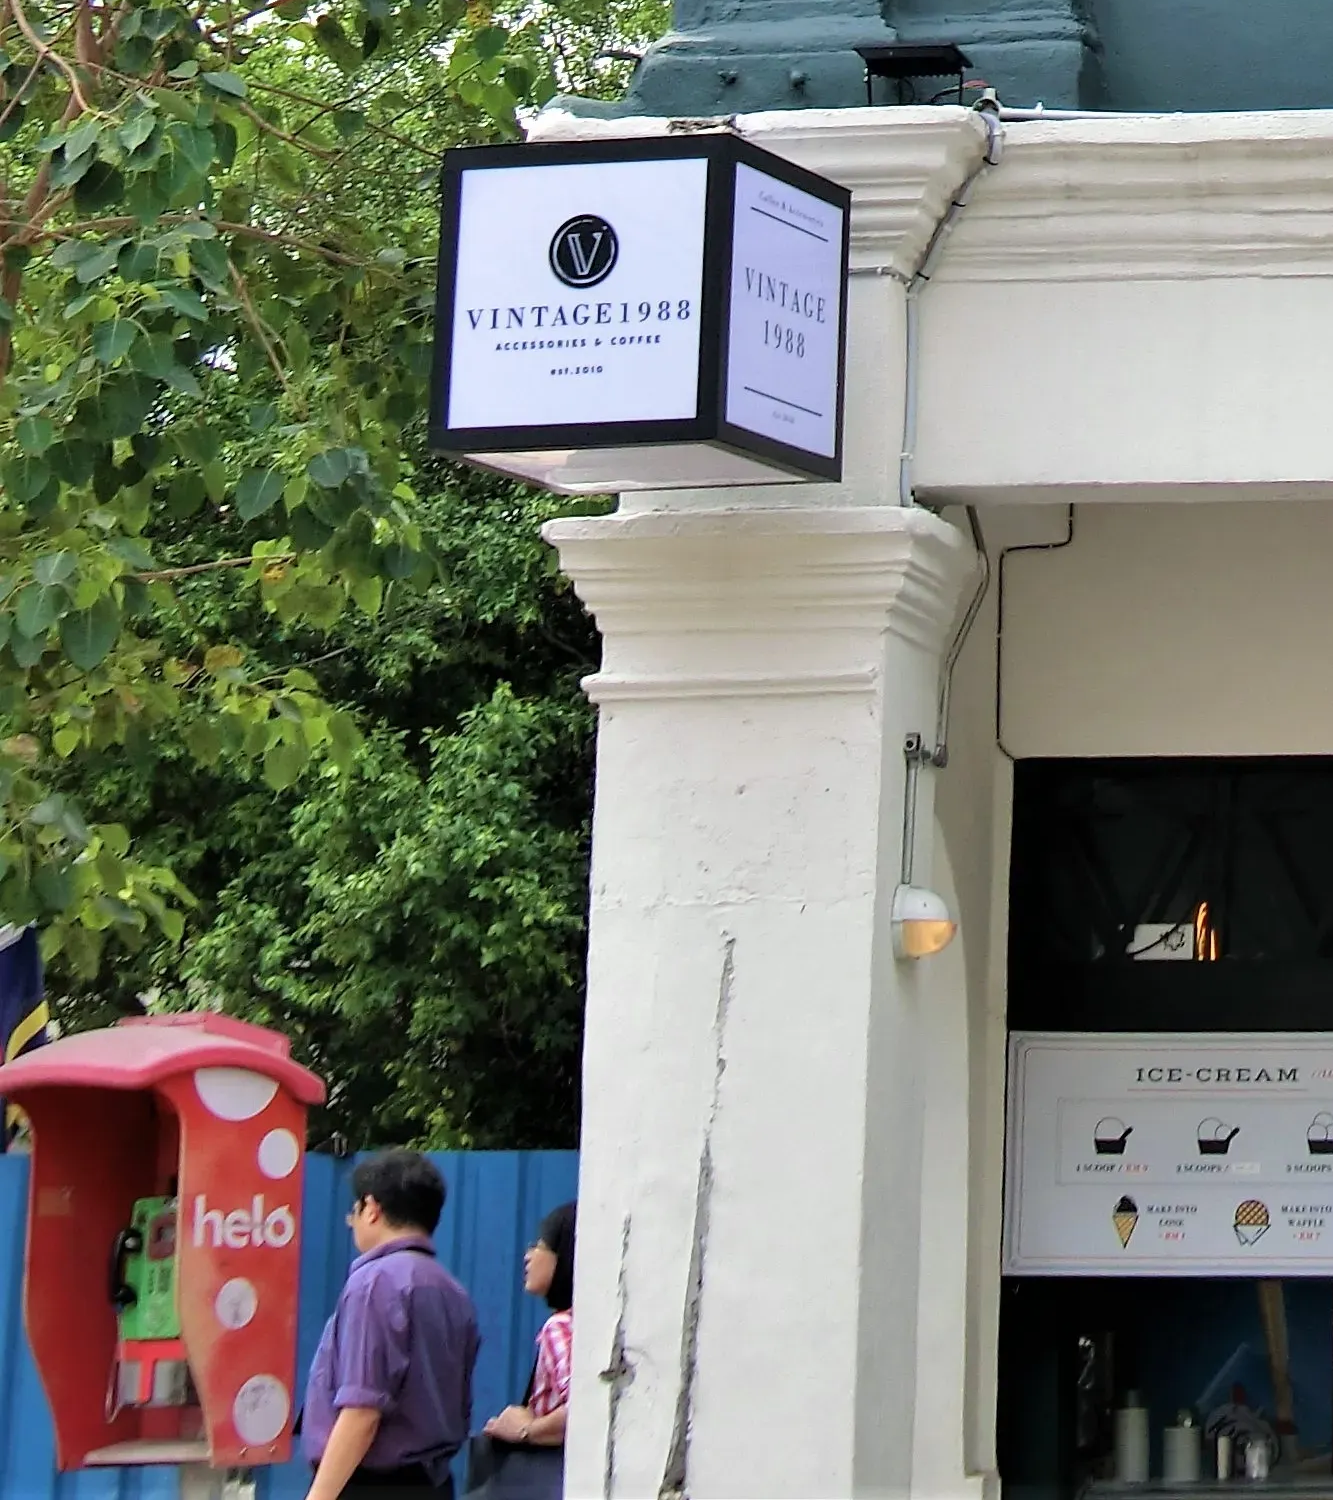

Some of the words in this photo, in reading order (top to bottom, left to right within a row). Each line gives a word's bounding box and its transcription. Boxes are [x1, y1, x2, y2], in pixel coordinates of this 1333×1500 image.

[745, 266, 826, 324] VINTAGE
[466, 299, 691, 330] VINTAGE1988
[495, 338, 587, 352] ACCESSORIES
[610, 334, 662, 346] COFFEE
[763, 319, 806, 359] 1988
[1135, 1067, 1300, 1083] ICE-CREAM
[193, 1192, 297, 1249] helo
